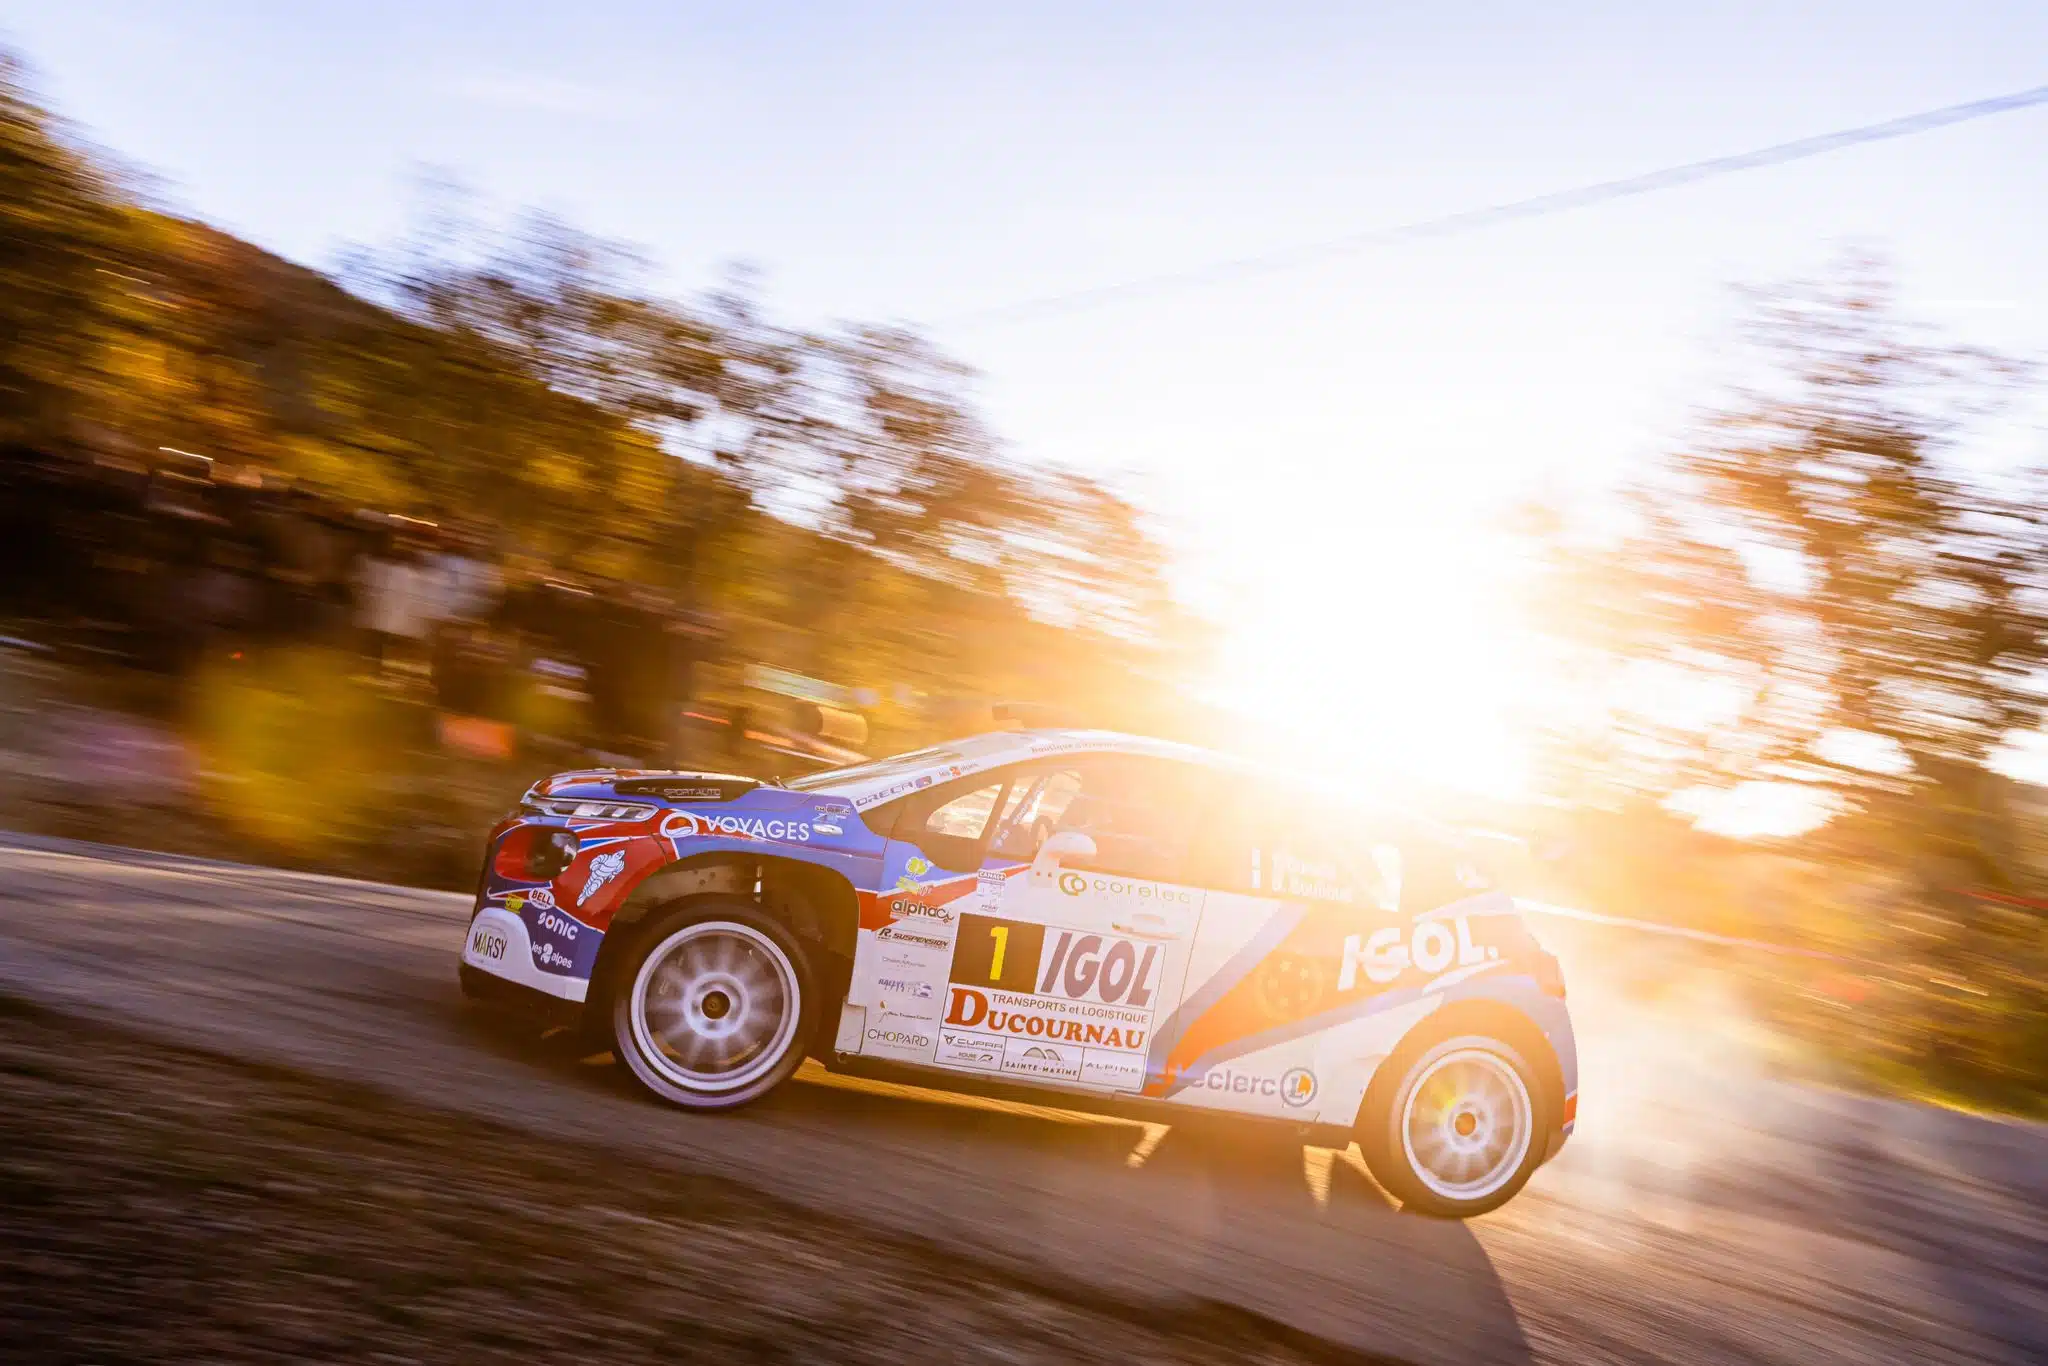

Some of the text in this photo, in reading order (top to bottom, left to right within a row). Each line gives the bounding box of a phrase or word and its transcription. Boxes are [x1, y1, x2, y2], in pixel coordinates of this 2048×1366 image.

[856, 781, 914, 806] ORECA
[703, 815, 810, 841] VOYAGES
[531, 889, 552, 906] BELL
[472, 931, 508, 961] MARSY
[551, 952, 573, 969] alpes
[989, 926, 1158, 1007] 1 IGOL
[944, 988, 1145, 1049] DUCOURNAU
[992, 993, 1149, 1025] TRANSPORTS et LOGISTIQUE
[867, 1028, 929, 1047] CHOPARD
[957, 1038, 1004, 1049] CUPRA
[1004, 1061, 1079, 1077] SAINTE-MAXIME
[1085, 1062, 1141, 1074] ALPINE
